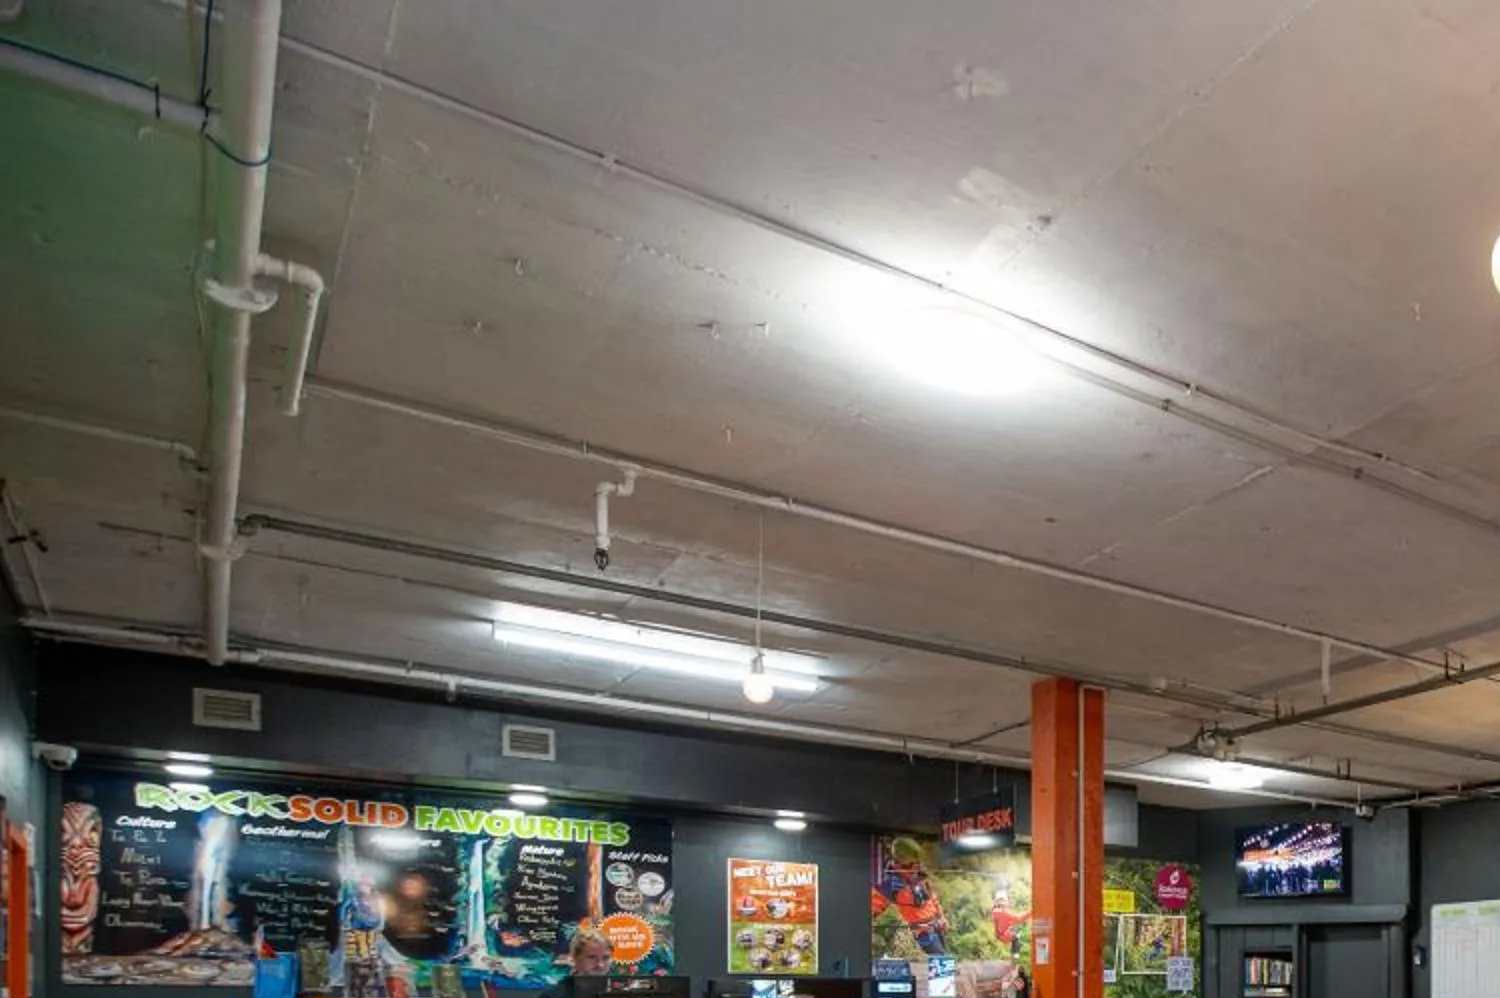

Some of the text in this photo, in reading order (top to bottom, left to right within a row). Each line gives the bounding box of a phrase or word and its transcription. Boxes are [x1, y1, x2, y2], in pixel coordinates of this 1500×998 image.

[115, 815, 177, 829] Culture
[415, 804, 632, 847] FAVOURITES
[977, 807, 1012, 832] DESK
[240, 823, 331, 841] Geothermal
[608, 851, 640, 862] Staff
